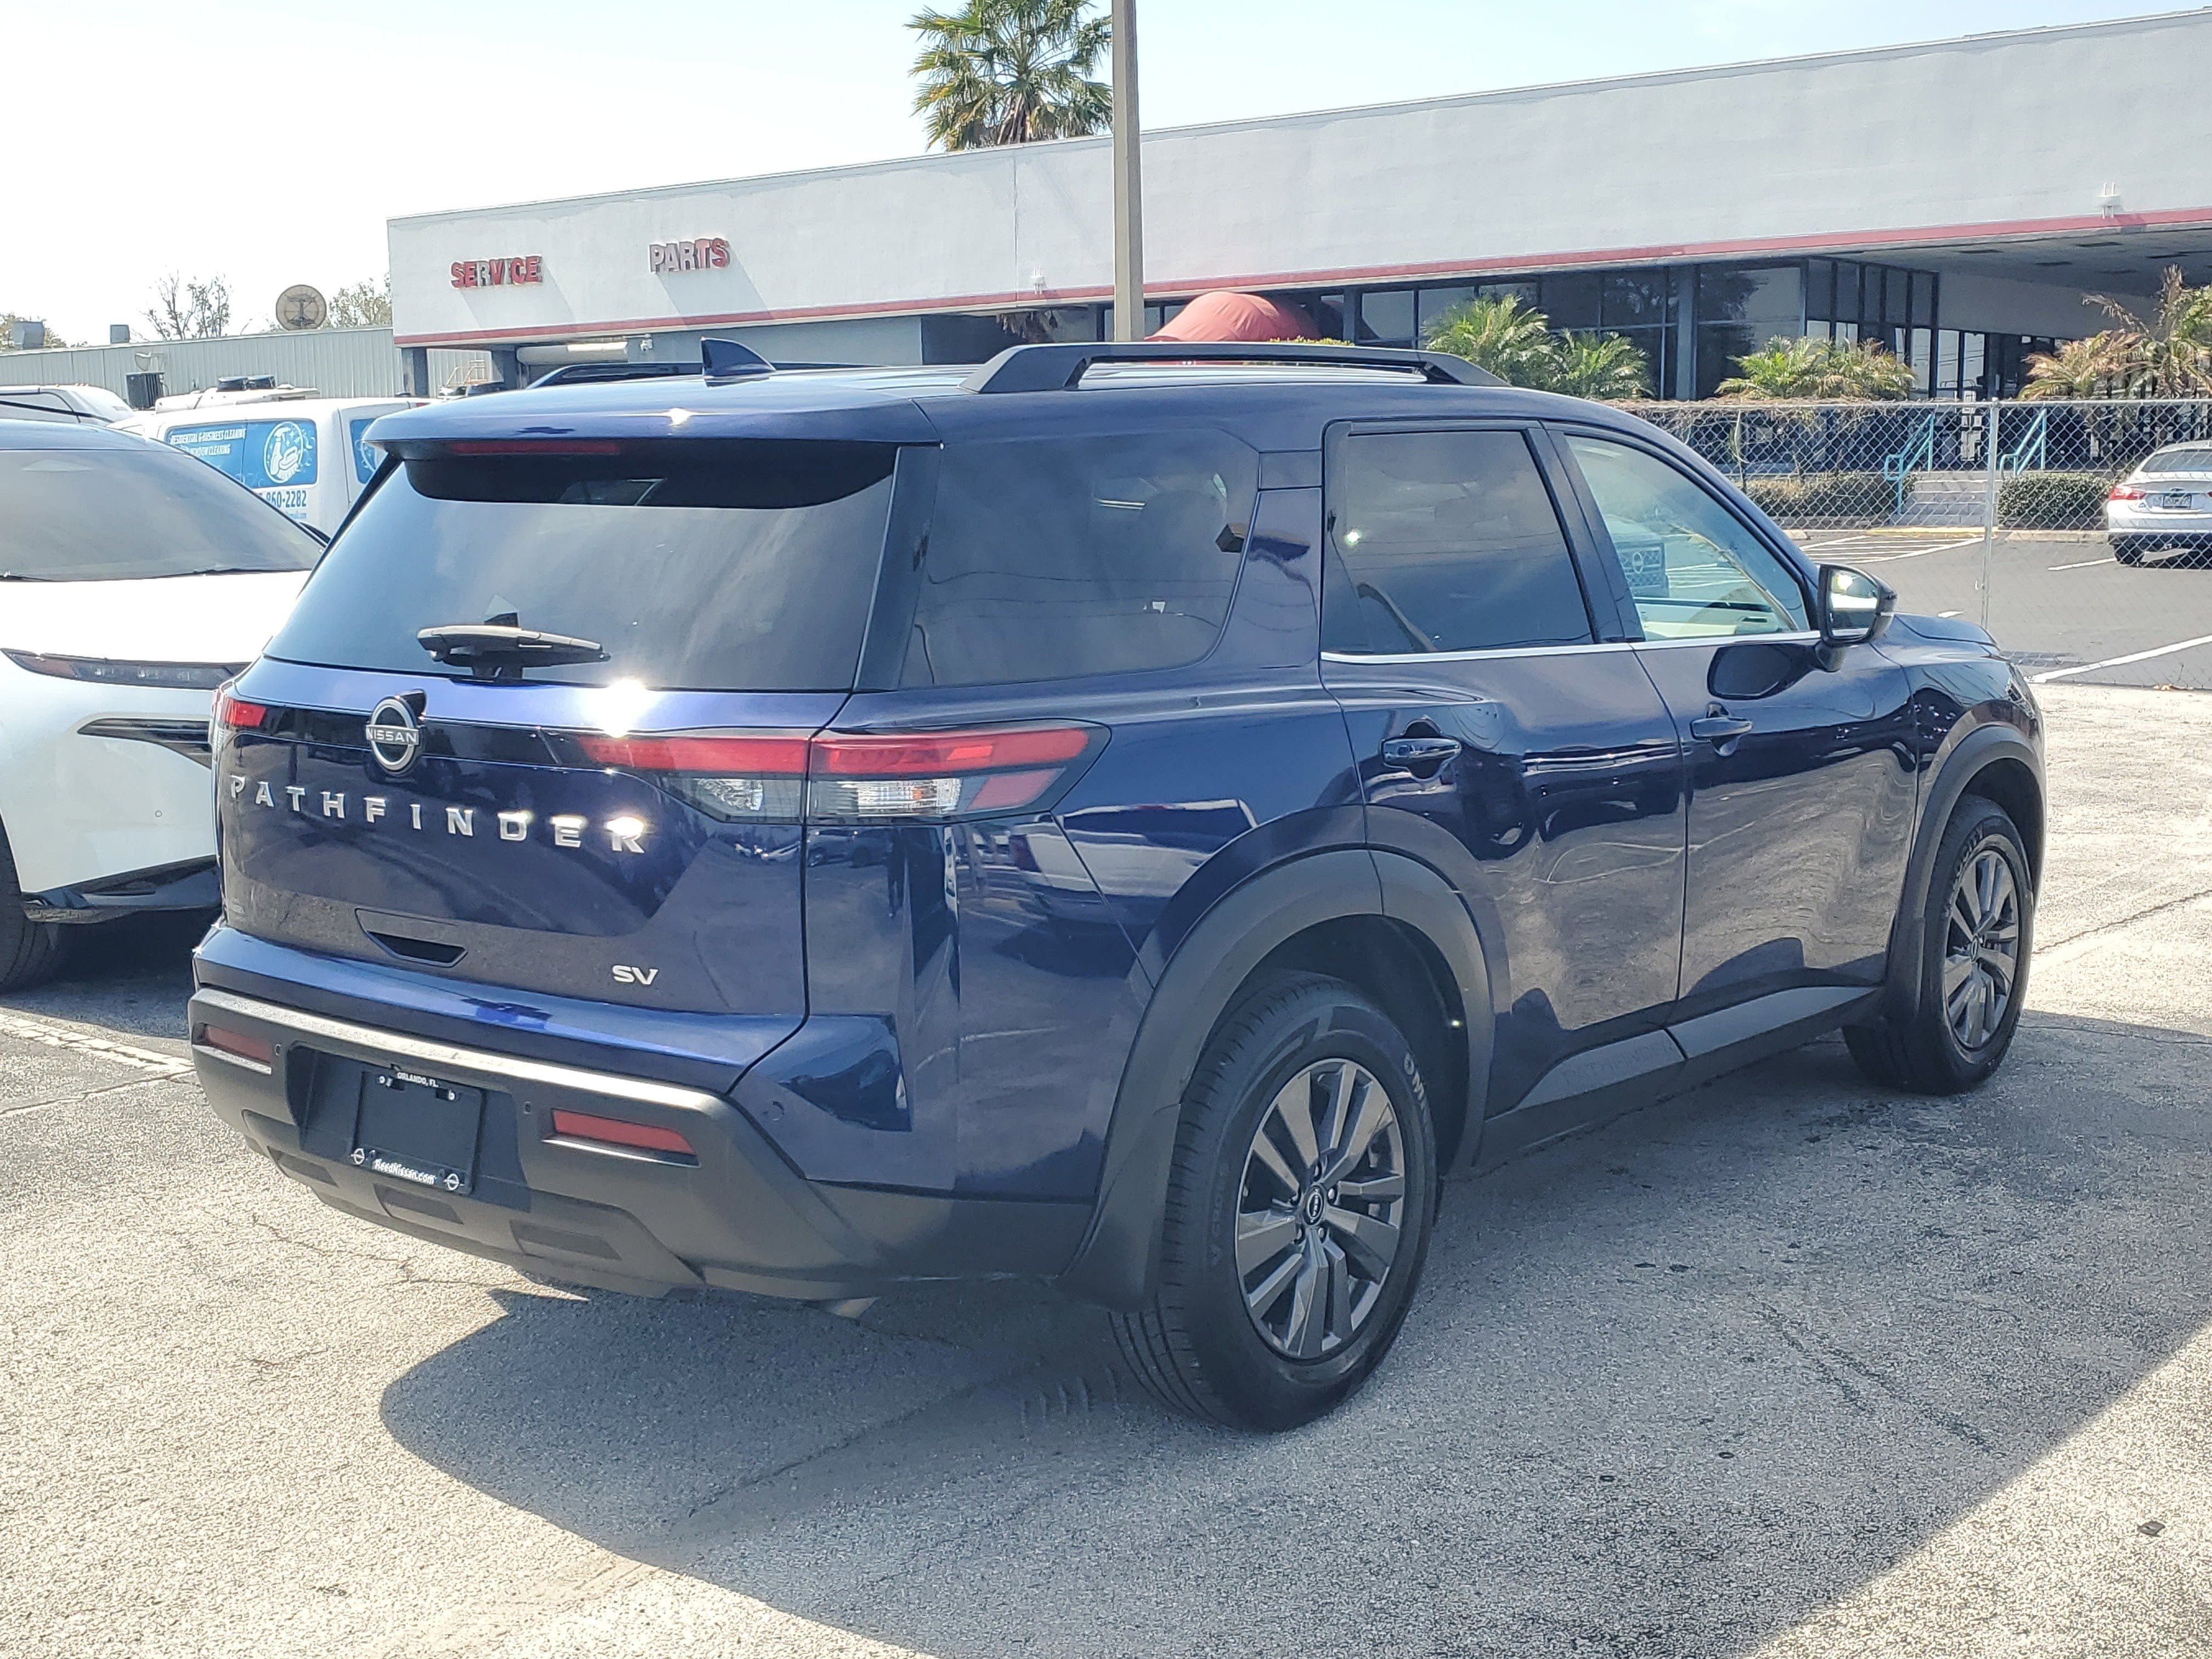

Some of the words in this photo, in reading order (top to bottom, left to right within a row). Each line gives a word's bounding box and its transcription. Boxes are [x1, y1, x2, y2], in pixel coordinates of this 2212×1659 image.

[650, 238, 730, 273] PARTS
[450, 256, 542, 289] SERVICE
[366, 727, 417, 743] NISSAN
[230, 775, 646, 854] PATHFINDER
[612, 965, 658, 985] SV
[397, 1071, 428, 1087] ORLANDO,
[373, 1159, 436, 1186] ReedNissan.com
